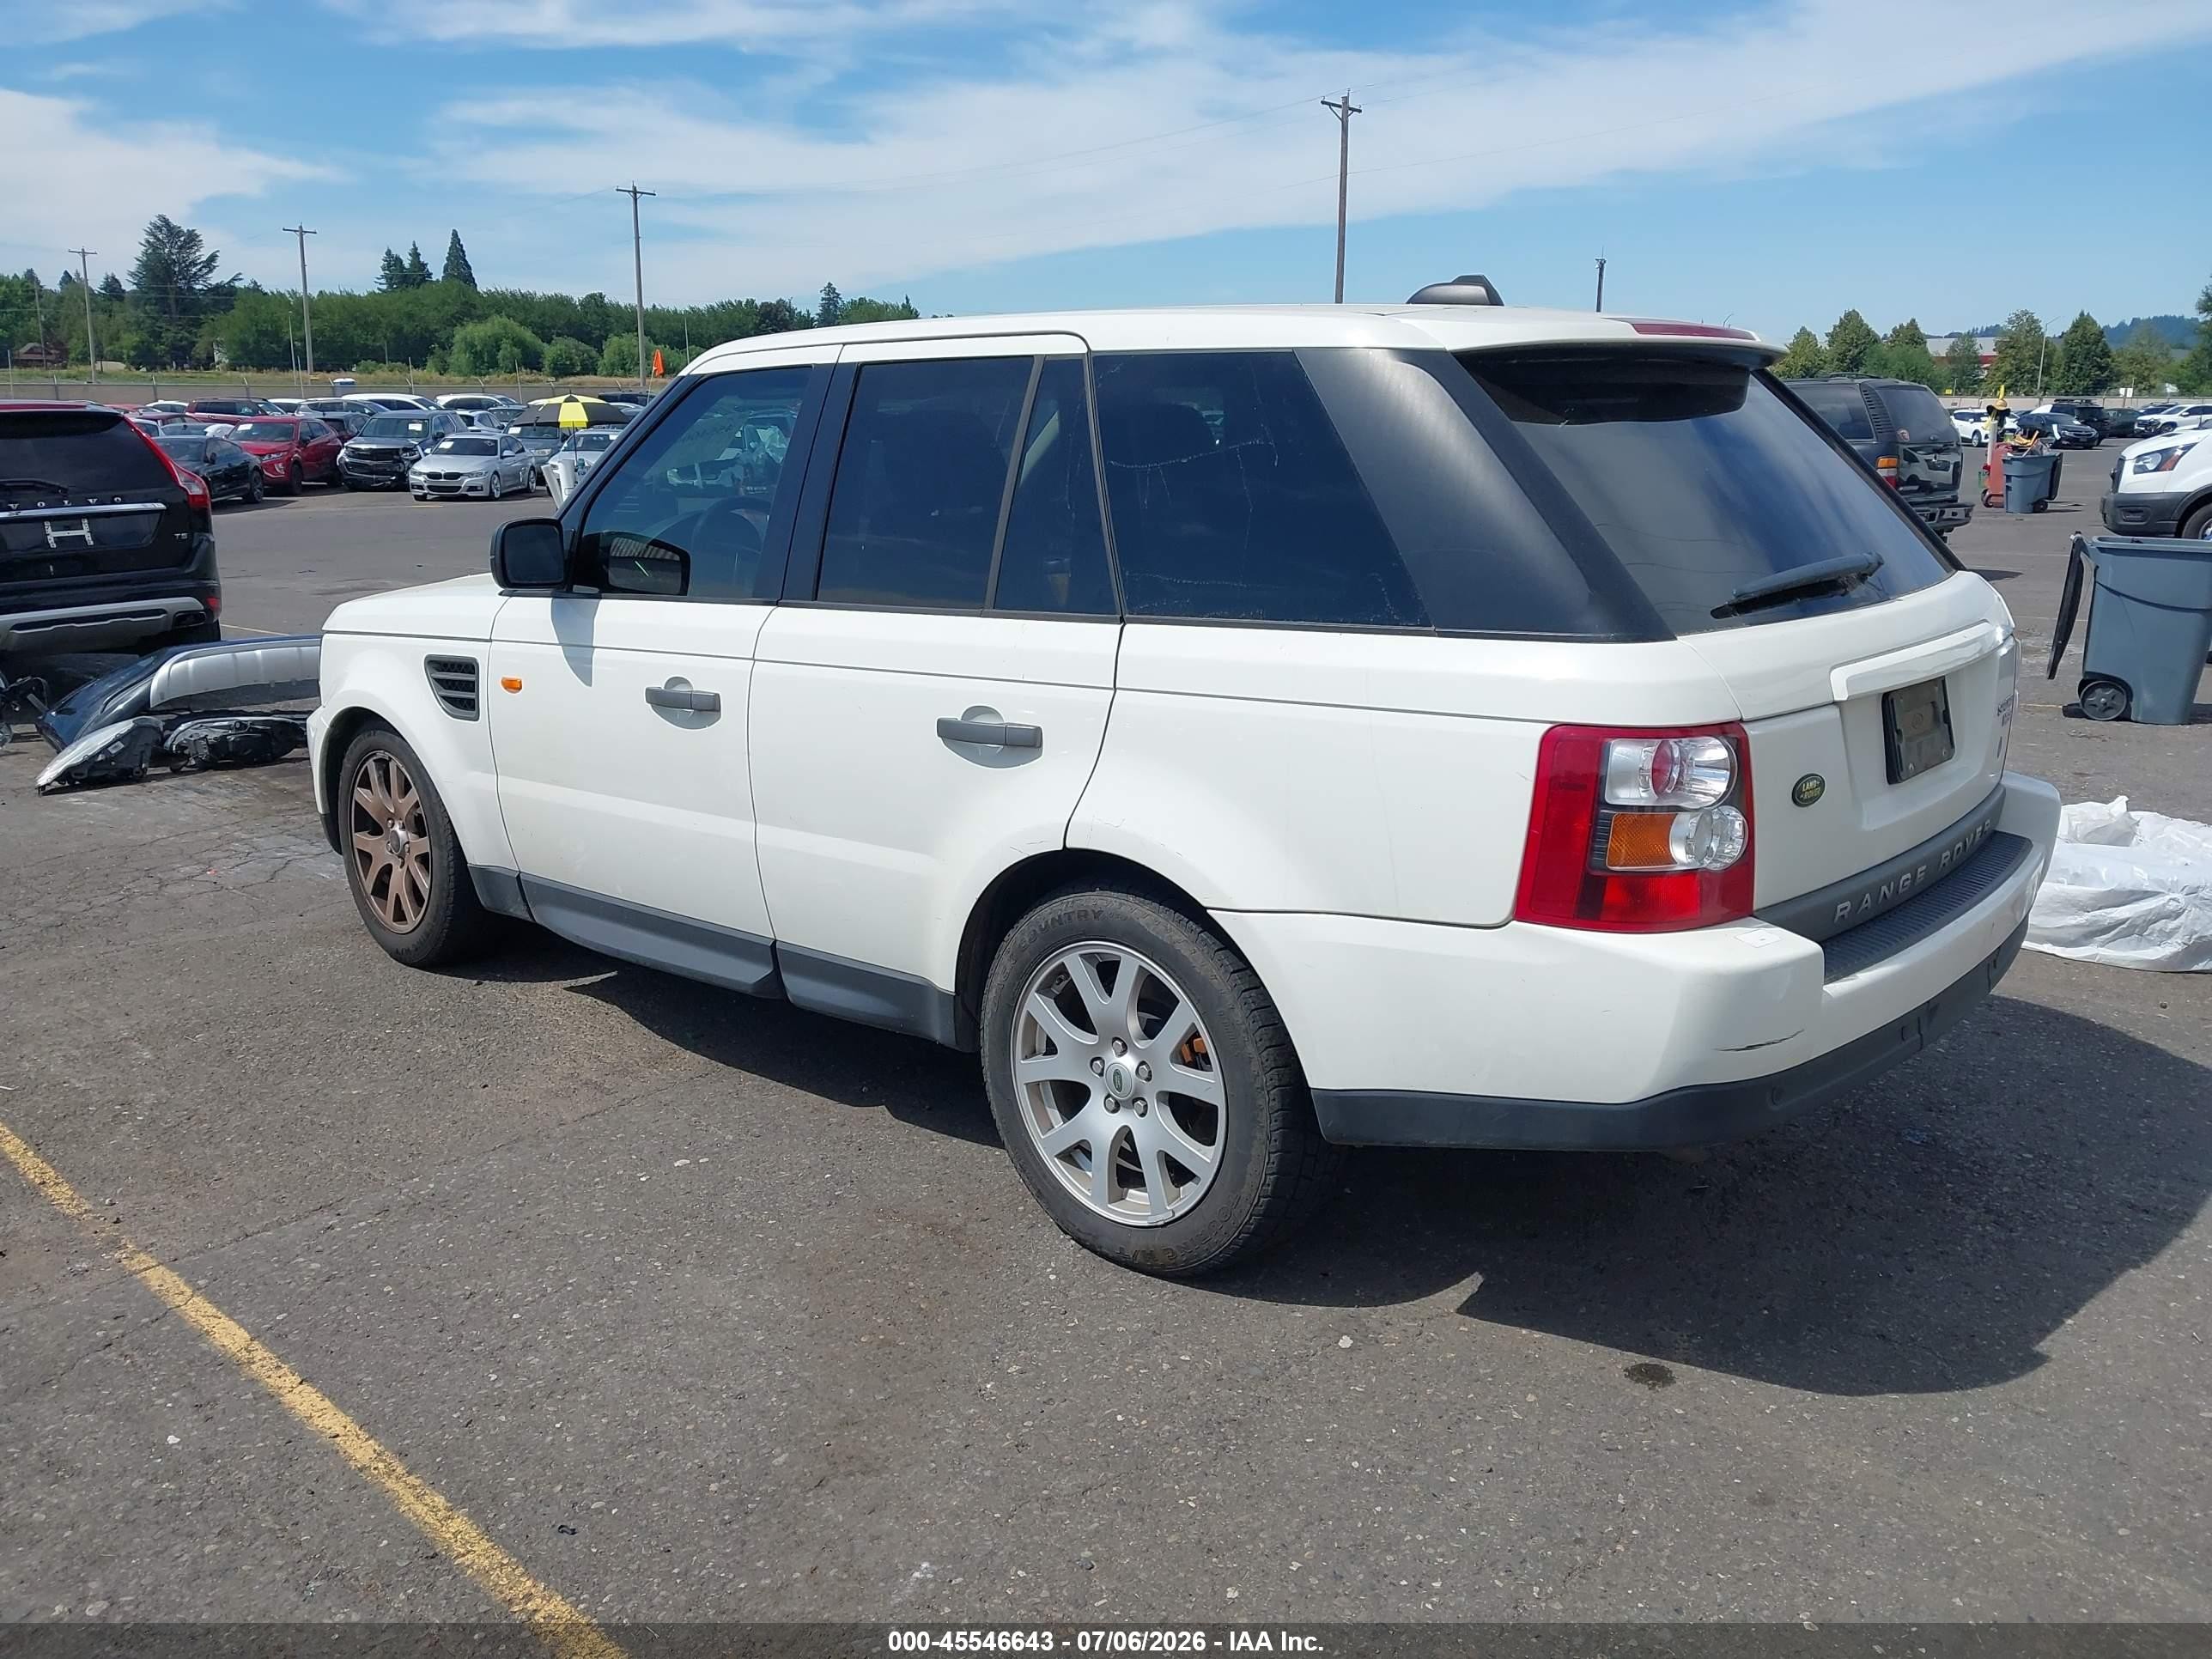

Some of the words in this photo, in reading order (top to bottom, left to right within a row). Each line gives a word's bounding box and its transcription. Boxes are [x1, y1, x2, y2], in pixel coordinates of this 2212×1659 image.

[8, 496, 122, 510] VOLVO
[1939, 818, 1991, 872] ROVER
[1834, 865, 1927, 923] RANGE
[1018, 908, 1104, 952] COUNTRY
